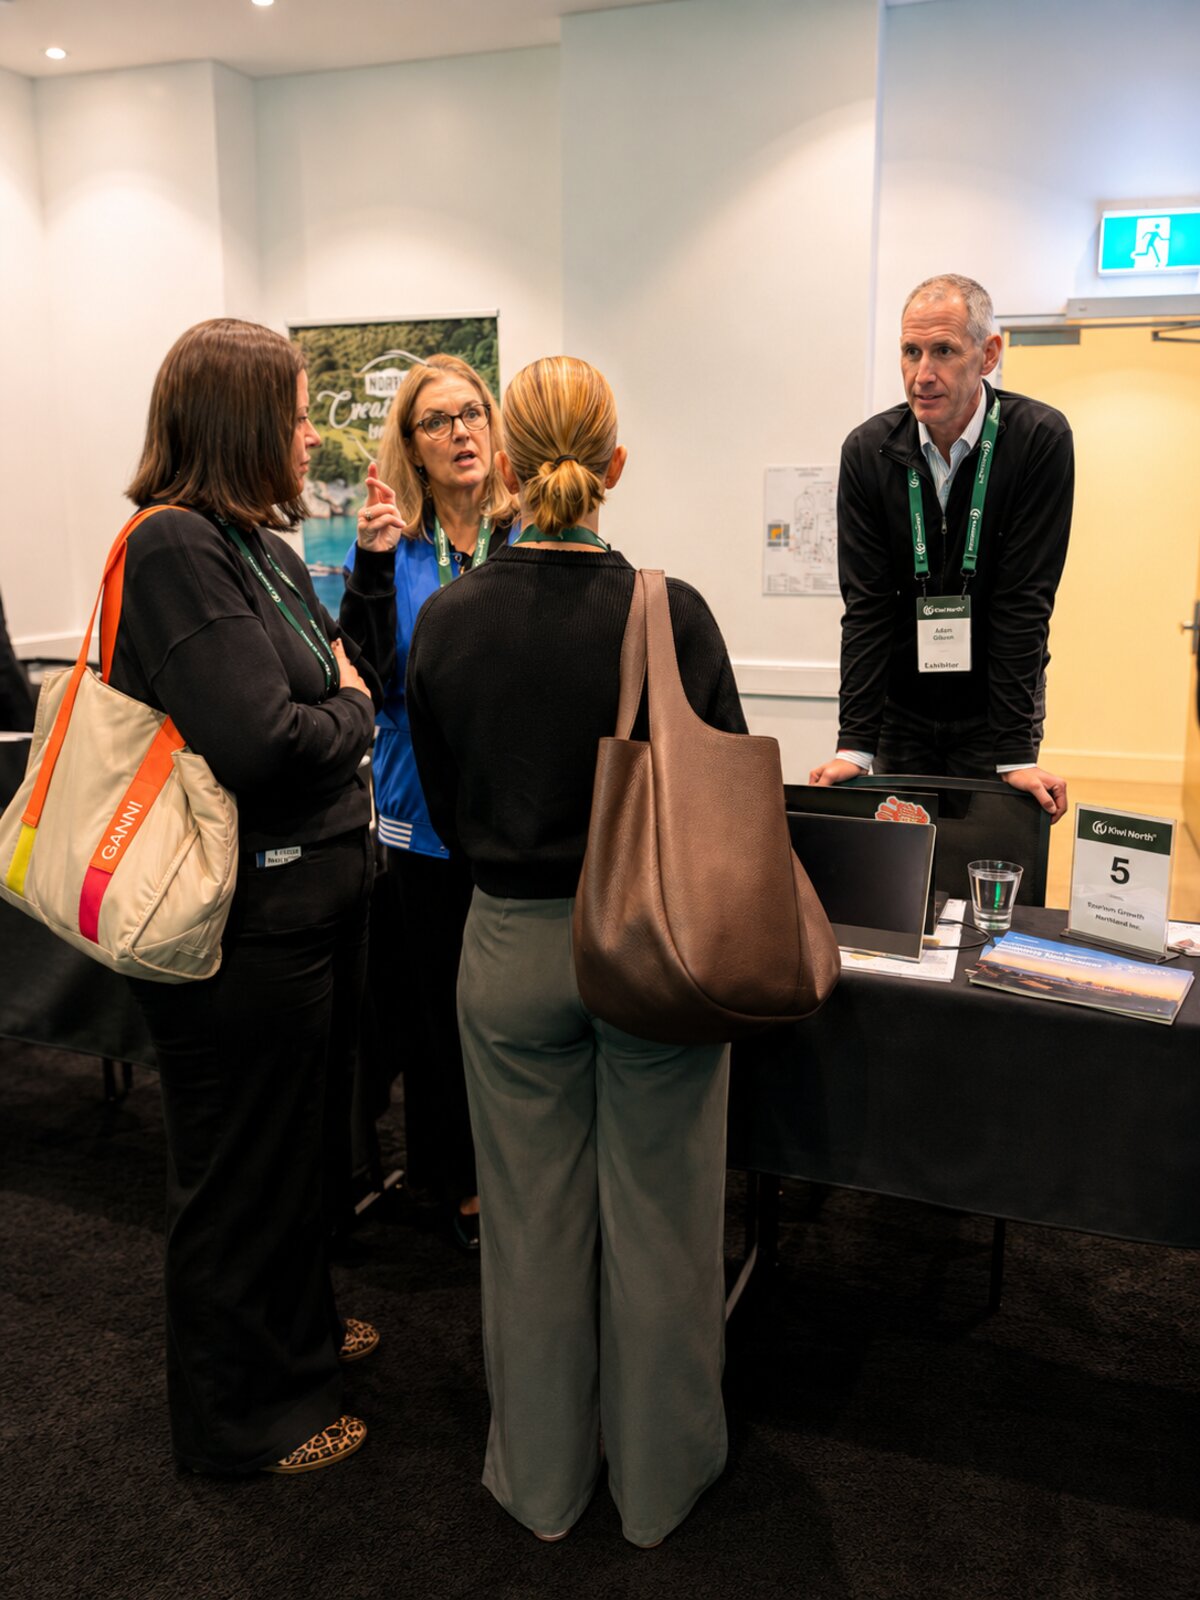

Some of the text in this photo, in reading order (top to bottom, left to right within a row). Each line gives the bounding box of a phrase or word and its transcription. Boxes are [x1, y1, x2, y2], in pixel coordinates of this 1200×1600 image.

[101, 800, 143, 860] GANNI
[1108, 826, 1154, 842] Kiwi North
[1110, 856, 1130, 885] 5
[1095, 914, 1128, 927] Northland
[1117, 908, 1145, 920] Growth
